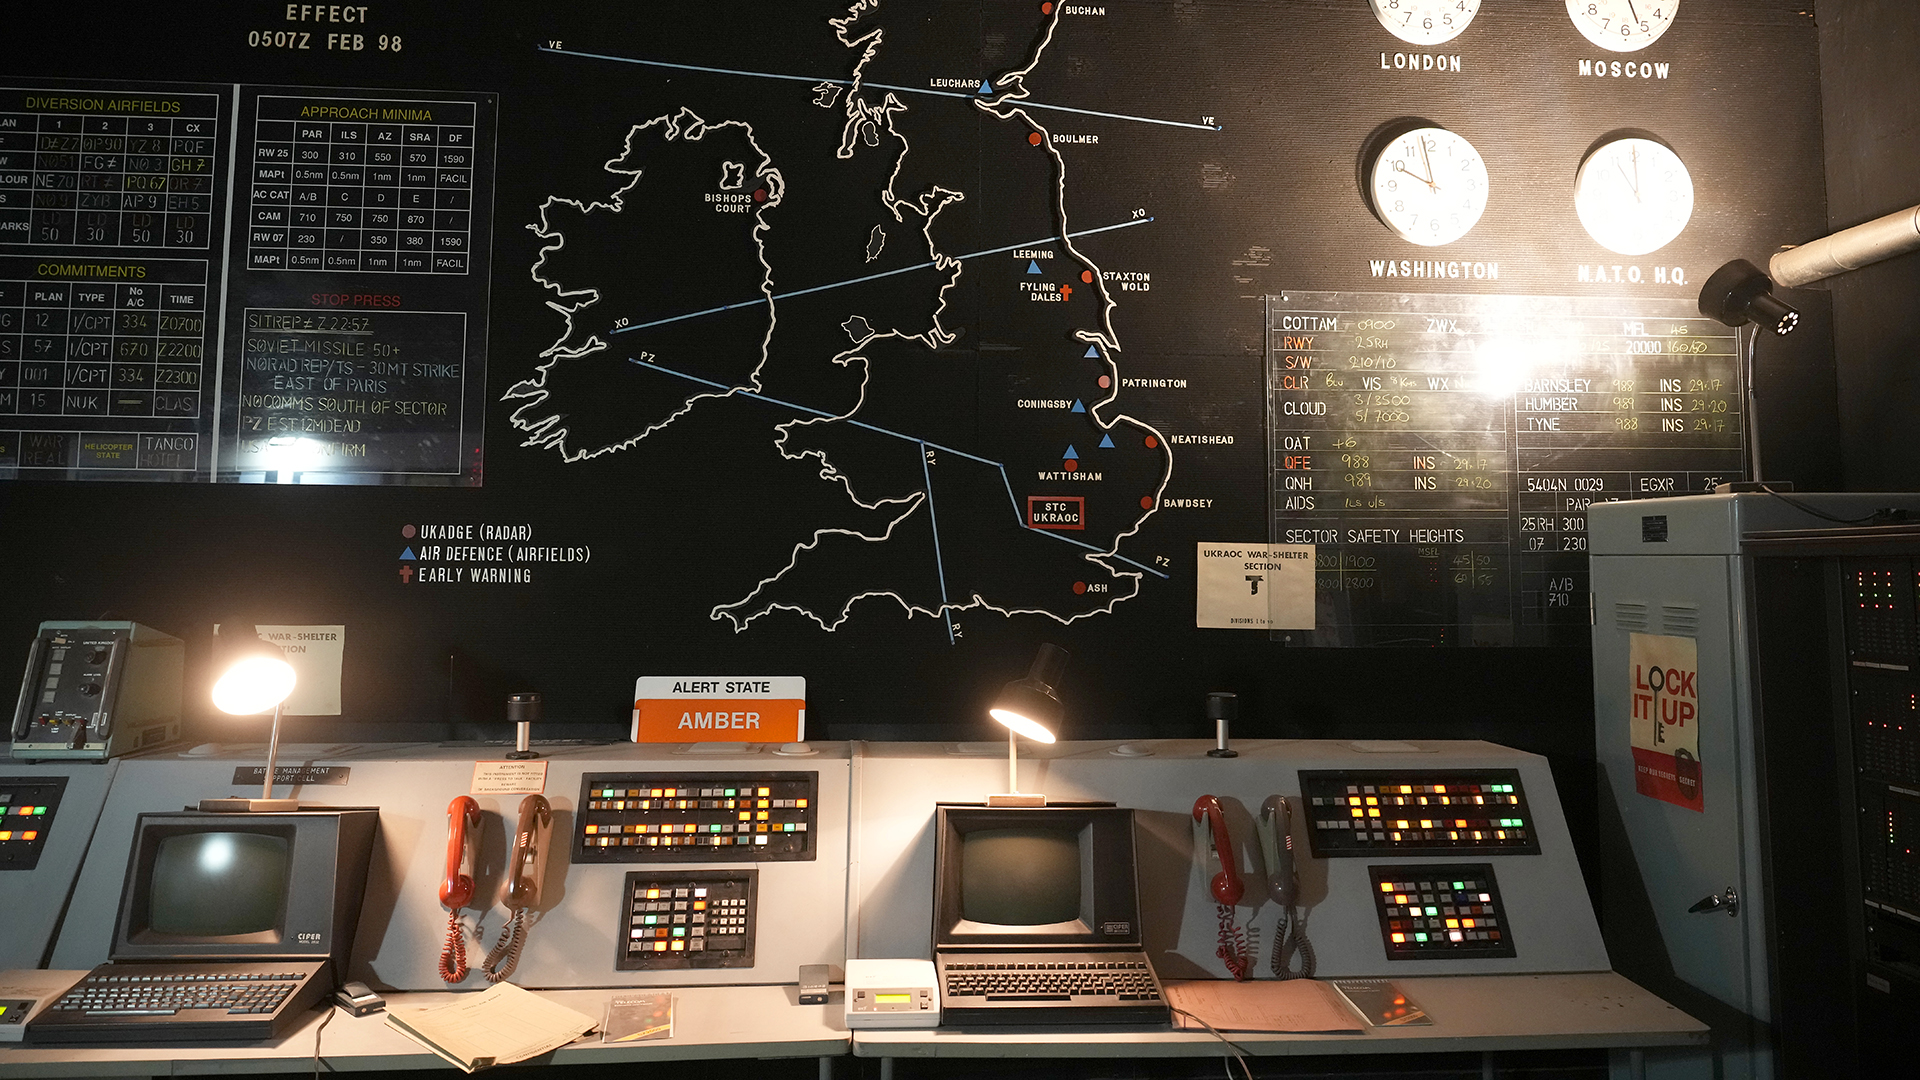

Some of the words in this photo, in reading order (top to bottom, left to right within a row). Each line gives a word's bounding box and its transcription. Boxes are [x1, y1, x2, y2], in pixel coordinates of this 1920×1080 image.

[286, 4, 368, 23] EFFECT
[1065, 6, 1106, 16] BUCHAN
[248, 31, 310, 49] 0507Z
[327, 34, 364, 51] FEB
[378, 35, 402, 52] 98
[548, 40, 562, 49] VE
[1380, 52, 1461, 72] LONDON
[1579, 60, 1670, 79] MOSCOW
[930, 78, 981, 89] LEUCHARS
[26, 97, 103, 111] DIVERSION
[107, 100, 181, 113] AIRFIELDS
[301, 106, 378, 120] APPROACH
[382, 108, 432, 121] MINIMA
[1202, 116, 1214, 125] VE
[186, 124, 201, 132] CX
[302, 130, 322, 139] PAR
[341, 131, 357, 140] ILS
[378, 132, 392, 141] AZ
[409, 133, 431, 142] SRA
[449, 134, 462, 143] DF
[1052, 134, 1099, 145] BOULMER
[258, 149, 275, 157] RW
[277, 149, 288, 157] 25
[301, 151, 318, 159] 300
[339, 152, 356, 161] 310
[374, 153, 391, 161] 550
[409, 154, 426, 162] 570
[443, 155, 464, 164] 1590
[259, 170, 285, 178] MAPt
[295, 170, 323, 179] 0.5nm
[332, 171, 359, 180] 0.5nm
[440, 174, 467, 183] FACIL
[253, 190, 268, 199] AC
[269, 191, 289, 199] CAT
[299, 192, 317, 201] A/B
[704, 193, 752, 203] BISHOPS
[715, 205, 751, 214] COURT
[1132, 209, 1146, 219] XO
[258, 212, 281, 220] CAM
[300, 213, 316, 222] 710
[336, 214, 352, 222] 750
[372, 215, 388, 223] 750
[407, 215, 424, 224] 870
[87, 228, 104, 241] 30
[133, 229, 150, 243] 50
[176, 230, 193, 243] 30
[253, 234, 270, 242] RW
[272, 234, 283, 242] 07
[298, 235, 315, 244] 230
[371, 236, 387, 245] 350
[406, 237, 423, 245] 380
[440, 238, 462, 246] 1590
[1013, 250, 1054, 259] LEEMING
[37, 264, 146, 279] COMMITMENTS
[1103, 272, 1150, 281] STAXTON
[1369, 260, 1498, 280] WASHINGTON
[1578, 265, 1645, 284] N.A.T.O.
[1655, 267, 1689, 285] H.Q.
[129, 287, 143, 295] No
[1020, 282, 1055, 292] FYLING
[1121, 282, 1150, 291] WOLD
[35, 292, 63, 301] PLAN
[79, 293, 105, 302] TYPE
[127, 298, 145, 307] A/C
[170, 295, 194, 304] TIME
[311, 294, 350, 306] STOP
[354, 294, 401, 307] PRESS
[1031, 292, 1061, 302] DALES
[248, 314, 301, 329] SITREP
[615, 317, 629, 329] XO
[1283, 316, 1337, 331] COTTAM
[1427, 318, 1457, 332] ZWX
[248, 339, 299, 353] SOVIET
[304, 340, 364, 356] MISSILE
[1284, 336, 1313, 350] RWY
[640, 351, 656, 362] PZ
[1285, 356, 1312, 369] S/W
[413, 364, 459, 378] STRIKE
[274, 376, 315, 391] EAST
[346, 379, 387, 393] PARIS
[1122, 379, 1187, 388] PATRINGTON
[1284, 375, 1309, 389] CLR
[1363, 377, 1382, 390] VIS
[1660, 379, 1681, 392] INS
[395, 401, 448, 415] SECTOR
[1017, 400, 1072, 409] CONINGSBY
[1284, 402, 1326, 415] CLOUD
[1525, 398, 1578, 411] HUMBER
[1661, 398, 1682, 412] INS
[1527, 417, 1560, 431] TYNE
[1662, 419, 1683, 432] INS
[146, 436, 193, 451] TANGO
[1171, 436, 1234, 444] NEATISHEAD
[1284, 437, 1311, 450] OAT
[1284, 456, 1311, 470] QFE
[1414, 456, 1435, 470] INS
[1038, 472, 1102, 481] WATTISHAM
[1285, 477, 1312, 491] QNH
[1414, 477, 1436, 490] INS
[1527, 478, 1567, 492] 5404N
[1574, 478, 1604, 491] 0029
[1641, 478, 1674, 491] EGXR
[1045, 503, 1066, 511] STC
[1164, 499, 1213, 508] BAWDSEY
[1285, 496, 1315, 510] AIDS
[1034, 513, 1079, 522] UKRAOC
[421, 525, 473, 540] UKADGE
[479, 523, 532, 541] (RADAR)
[1285, 529, 1338, 544] SECTOR
[1348, 529, 1400, 543] SAFETY
[1409, 528, 1464, 543] HEIGHTS
[419, 546, 440, 561] AIR
[446, 546, 503, 561] DEFENCE
[508, 545, 591, 563] (AIRFIELDS)
[1204, 550, 1242, 558] UKRAOC
[1247, 551, 1308, 559] WAR-SHELTER
[1155, 556, 1170, 567] PZ
[419, 568, 463, 582] EARLY
[471, 568, 531, 583] WARNING
[1087, 584, 1108, 593] ASH
[268, 633, 337, 641] WAR-SHELTER
[672, 682, 720, 693] ALERT
[725, 682, 770, 693] STATE
[1636, 664, 1697, 698] LOCK
[1634, 693, 1652, 720] IT
[1662, 698, 1695, 727] UP
[678, 712, 760, 729] AMBER
[1679, 777, 1695, 786] SECRET
